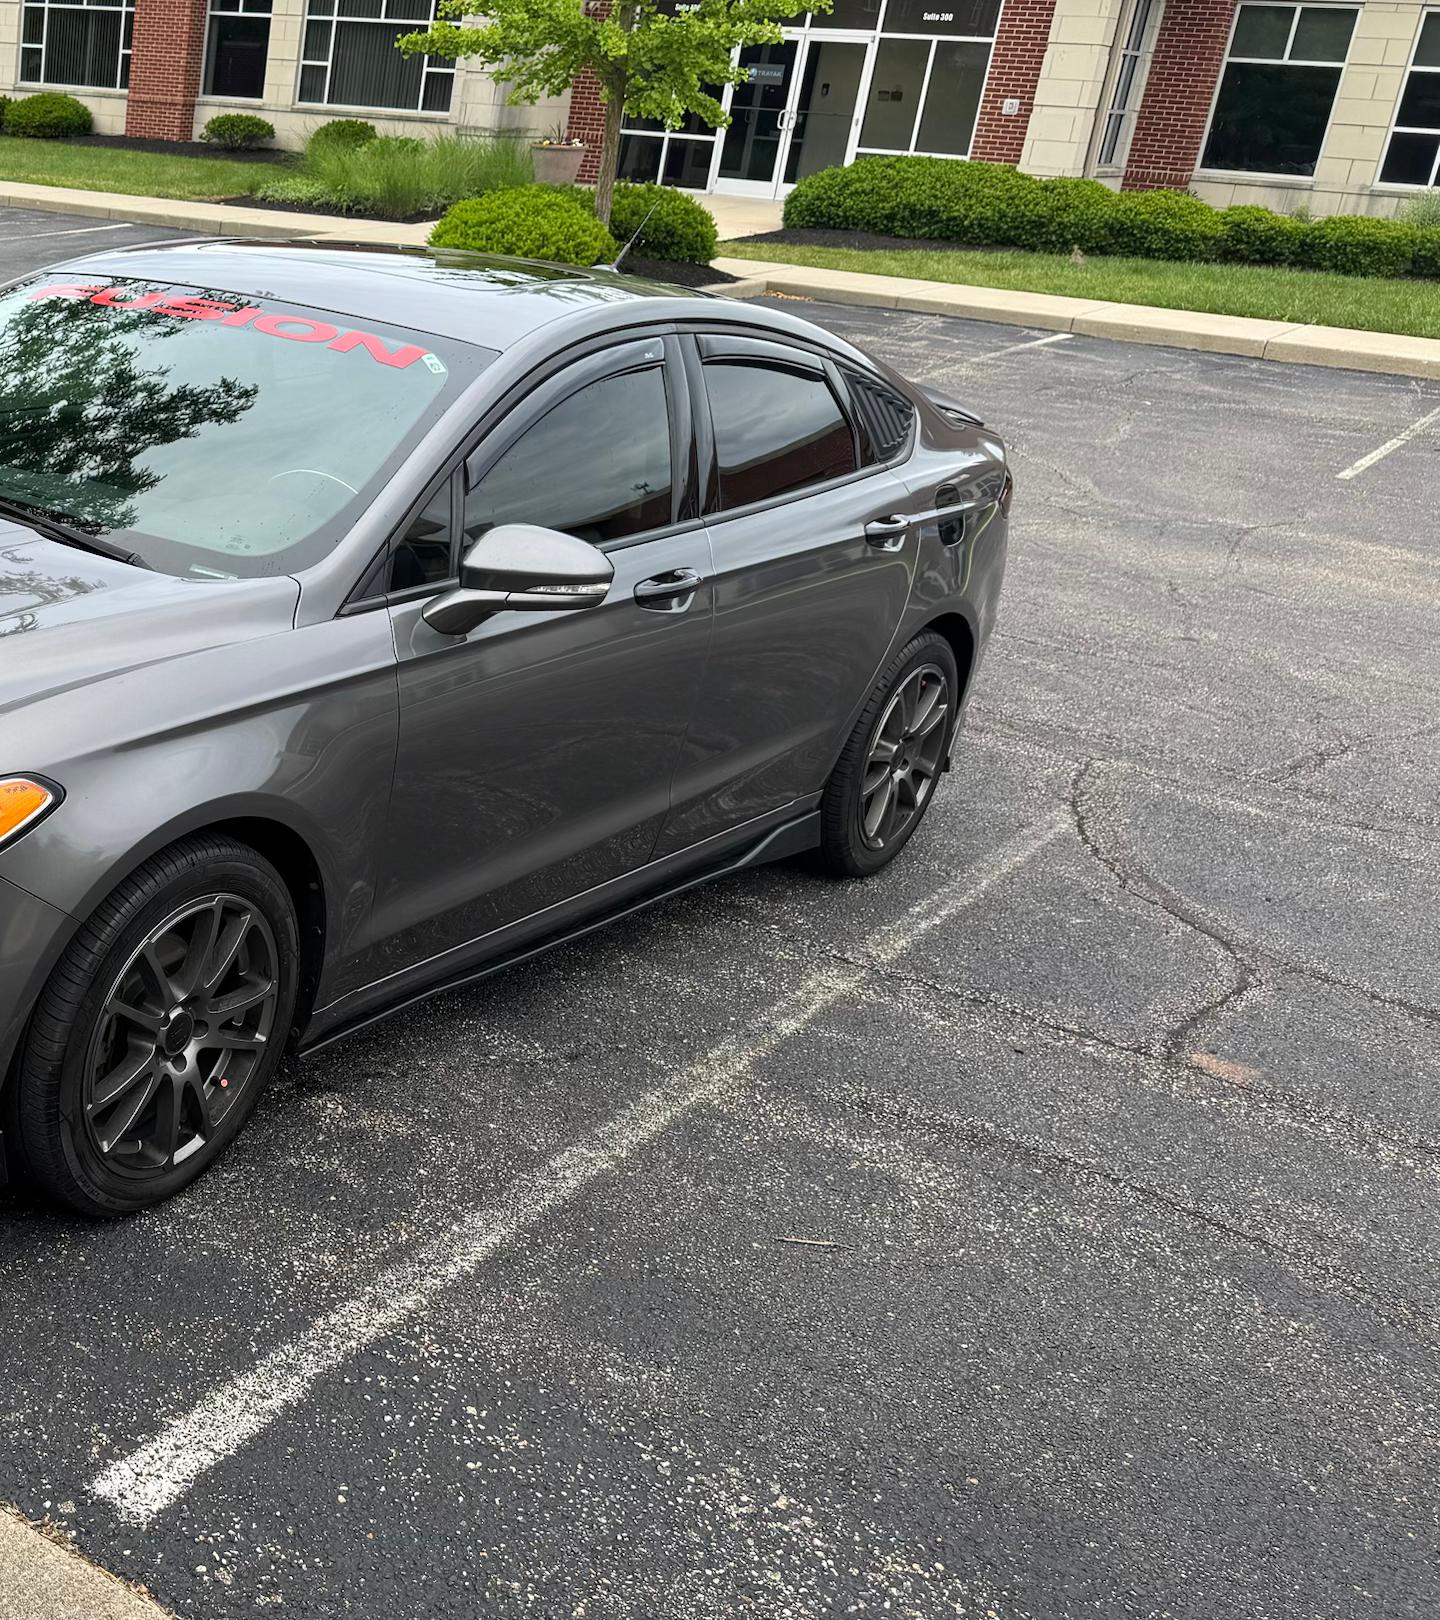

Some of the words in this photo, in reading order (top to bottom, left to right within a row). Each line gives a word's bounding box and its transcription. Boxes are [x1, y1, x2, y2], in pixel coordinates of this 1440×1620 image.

[923, 12, 940, 21] Suite
[940, 13, 954, 21] 300
[25, 285, 429, 369] FUSION
